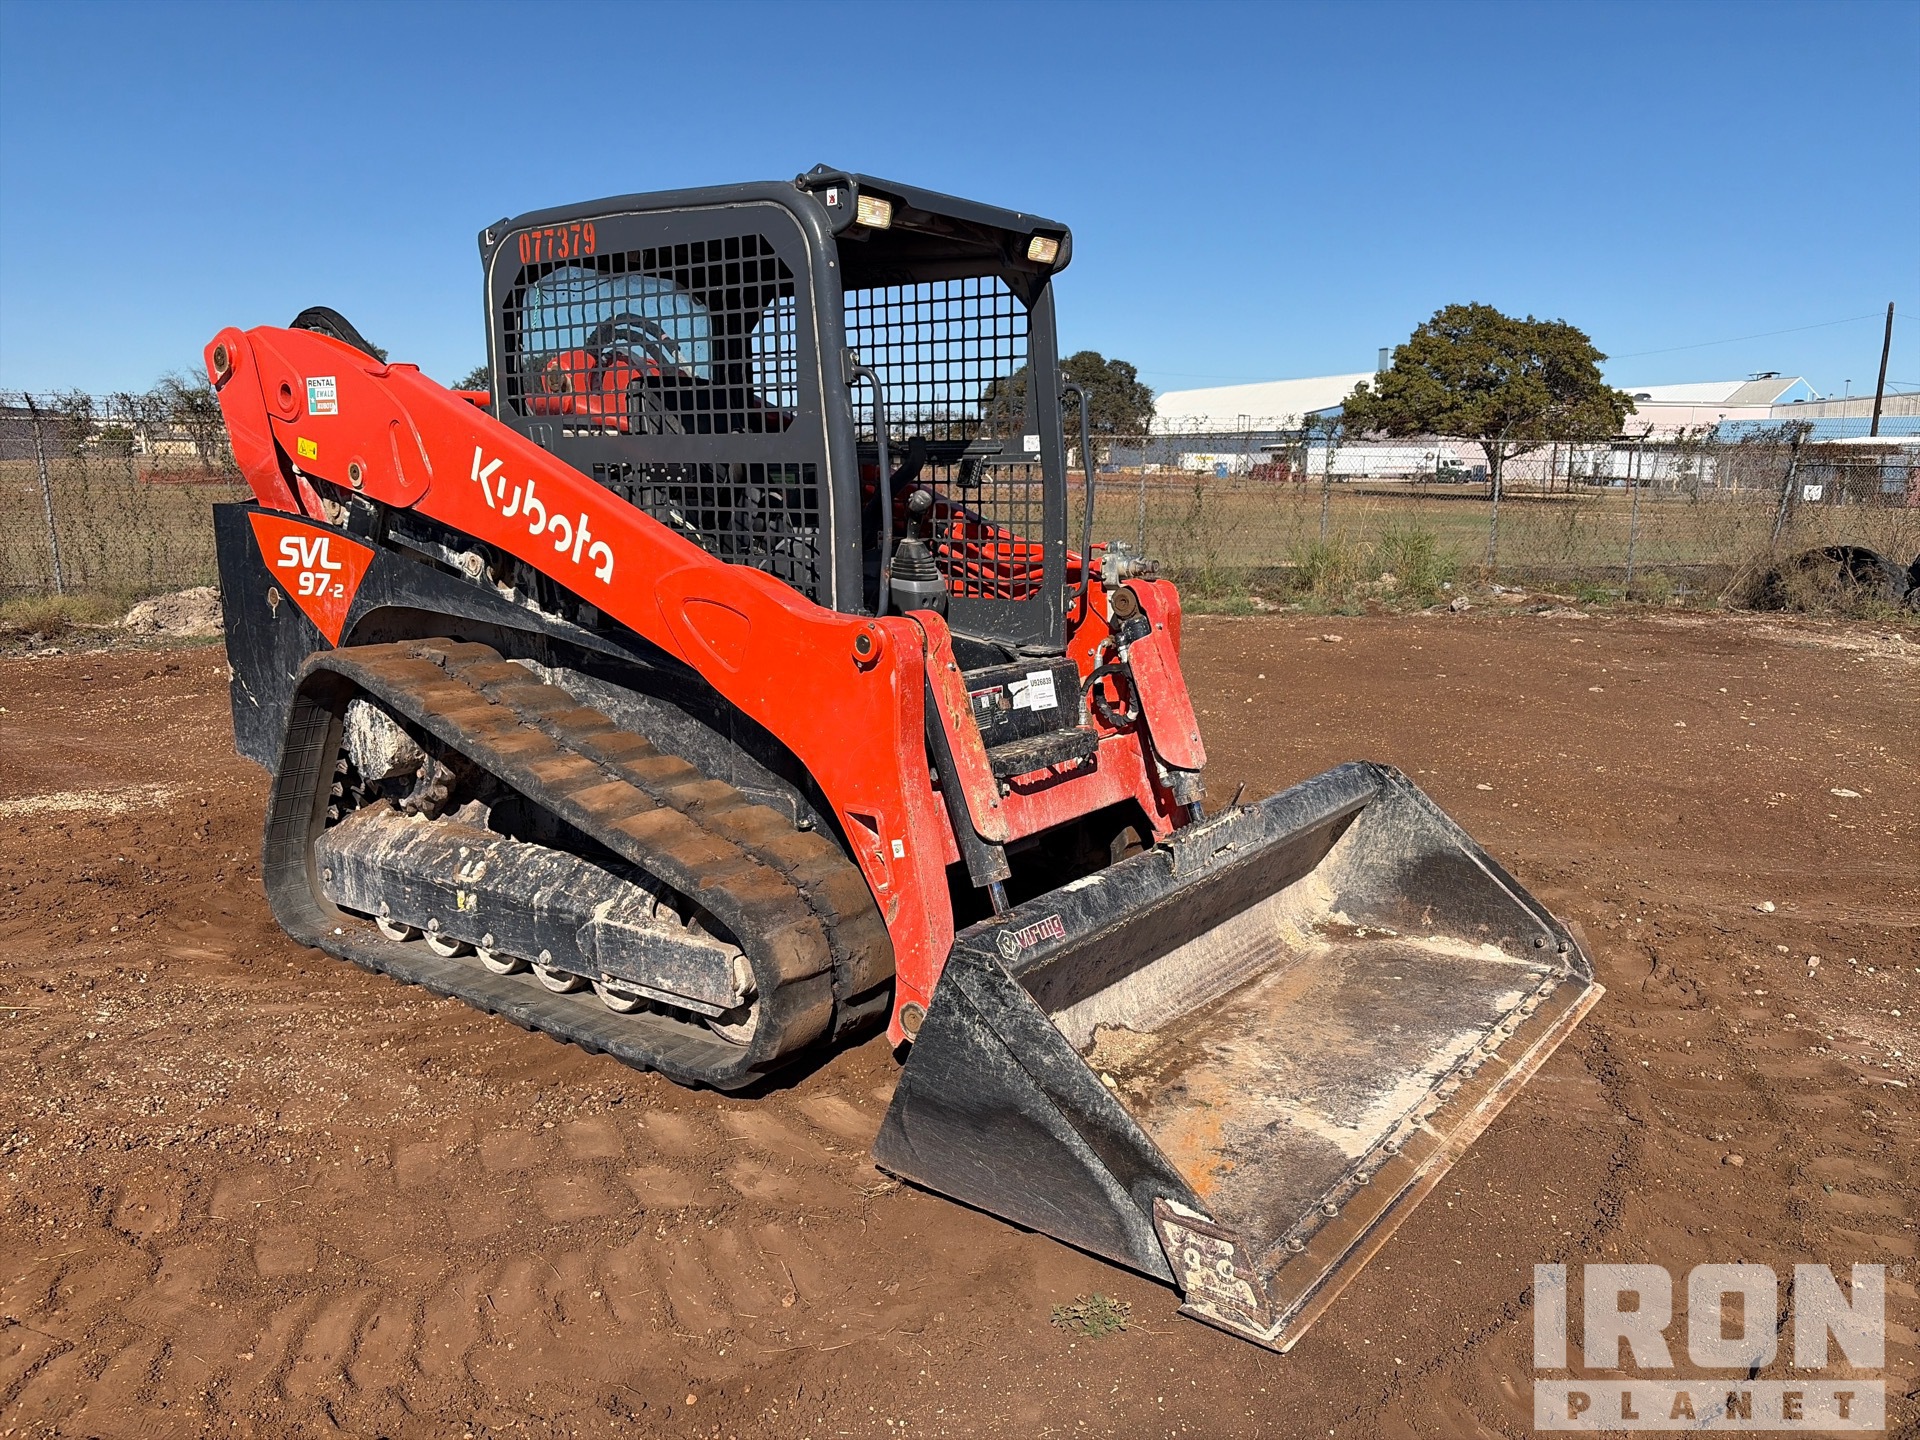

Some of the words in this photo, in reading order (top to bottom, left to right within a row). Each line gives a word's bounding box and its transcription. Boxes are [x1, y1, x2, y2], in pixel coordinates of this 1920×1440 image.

[519, 222, 595, 264] 077379
[308, 379, 334, 387] RENTAL
[316, 390, 334, 398] EWALD
[470, 445, 614, 585] Kubota
[277, 536, 341, 569] SVL
[298, 572, 344, 598] 97-2
